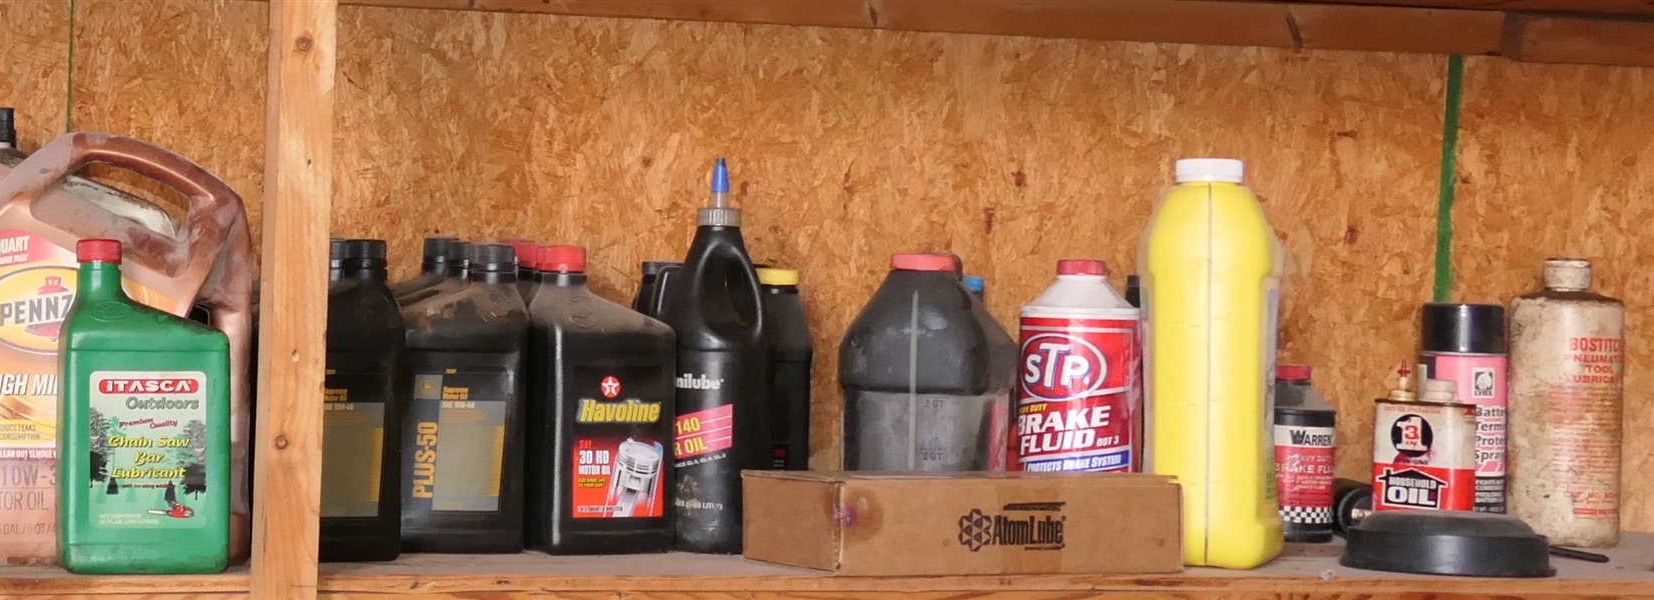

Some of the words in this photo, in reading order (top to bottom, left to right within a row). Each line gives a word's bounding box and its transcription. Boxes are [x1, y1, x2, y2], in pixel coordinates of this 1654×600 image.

[0, 293, 74, 327] PENNZ
[1025, 343, 1090, 390] STP
[1586, 365, 1613, 374] TOOL
[106, 380, 191, 392] ITASCA
[125, 397, 200, 410] Outdoors
[1029, 403, 1047, 413] DUTY
[578, 399, 662, 423] Havoline
[119, 418, 154, 428] Premium
[149, 420, 178, 429] Quality
[676, 416, 701, 435] 140
[1018, 405, 1111, 436] BRAKE
[18, 424, 36, 432] LEAKS
[108, 435, 153, 447] Chain
[157, 436, 190, 447] Saw
[1020, 428, 1096, 456] FLUID
[1096, 437, 1113, 447] DOT
[1113, 436, 1120, 445] 3
[1289, 429, 1333, 447] WARREN
[684, 437, 709, 454] OIL
[15, 450, 28, 458] OUT
[28, 450, 53, 459] SLUDGE
[134, 452, 164, 466] Bar
[412, 421, 439, 499] PLUS-50
[579, 450, 593, 465] 30
[596, 450, 610, 465] HD
[578, 465, 600, 475] MOTOR
[601, 465, 611, 475] OIL
[1027, 459, 1063, 472] PROTECTS
[1062, 457, 1091, 471] BRAKE
[1091, 454, 1122, 469] SYSTEM
[1275, 463, 1315, 474] BRAKE
[111, 467, 186, 479] Lubricant
[1388, 476, 1437, 489] HOUSEHOLD
[27, 491, 49, 511] OIL
[1387, 485, 1436, 506] OIL
[3, 523, 20, 535] GAL
[992, 515, 1065, 546] AtomLube
